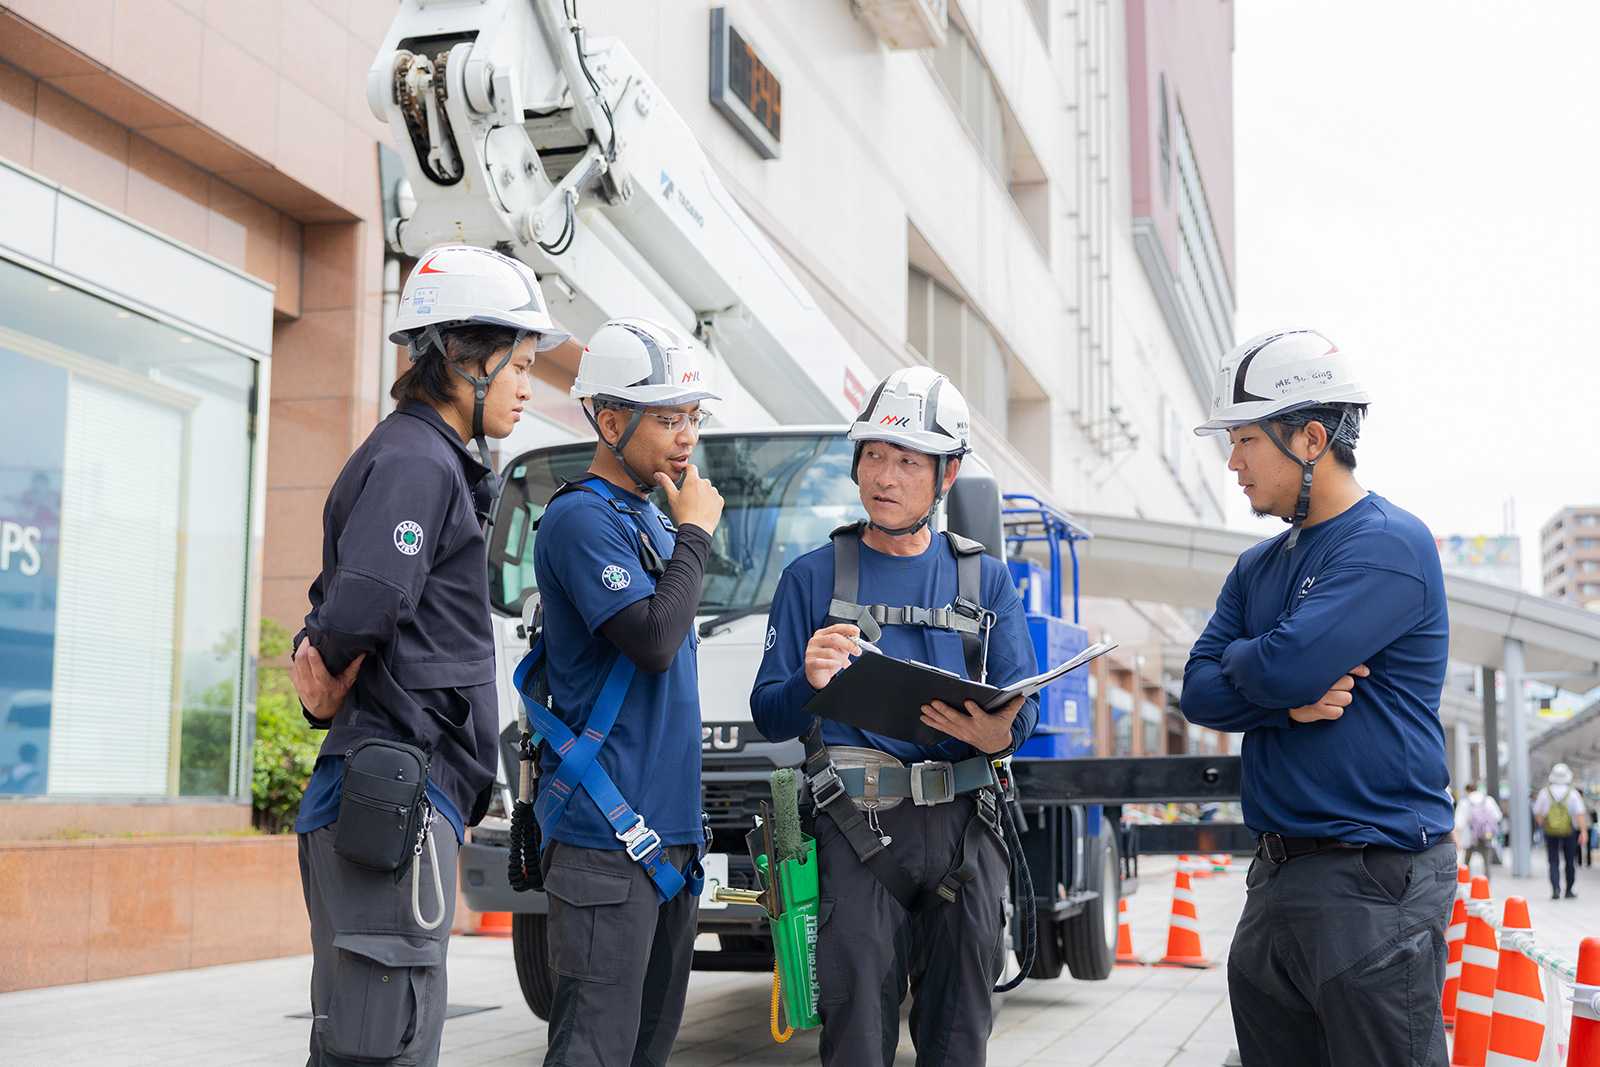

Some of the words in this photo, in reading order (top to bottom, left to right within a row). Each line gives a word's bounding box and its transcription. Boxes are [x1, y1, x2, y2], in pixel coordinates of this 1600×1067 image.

[398, 523, 422, 537] SAFETY
[397, 541, 419, 553] FIRST
[806, 914, 819, 943] BELT
